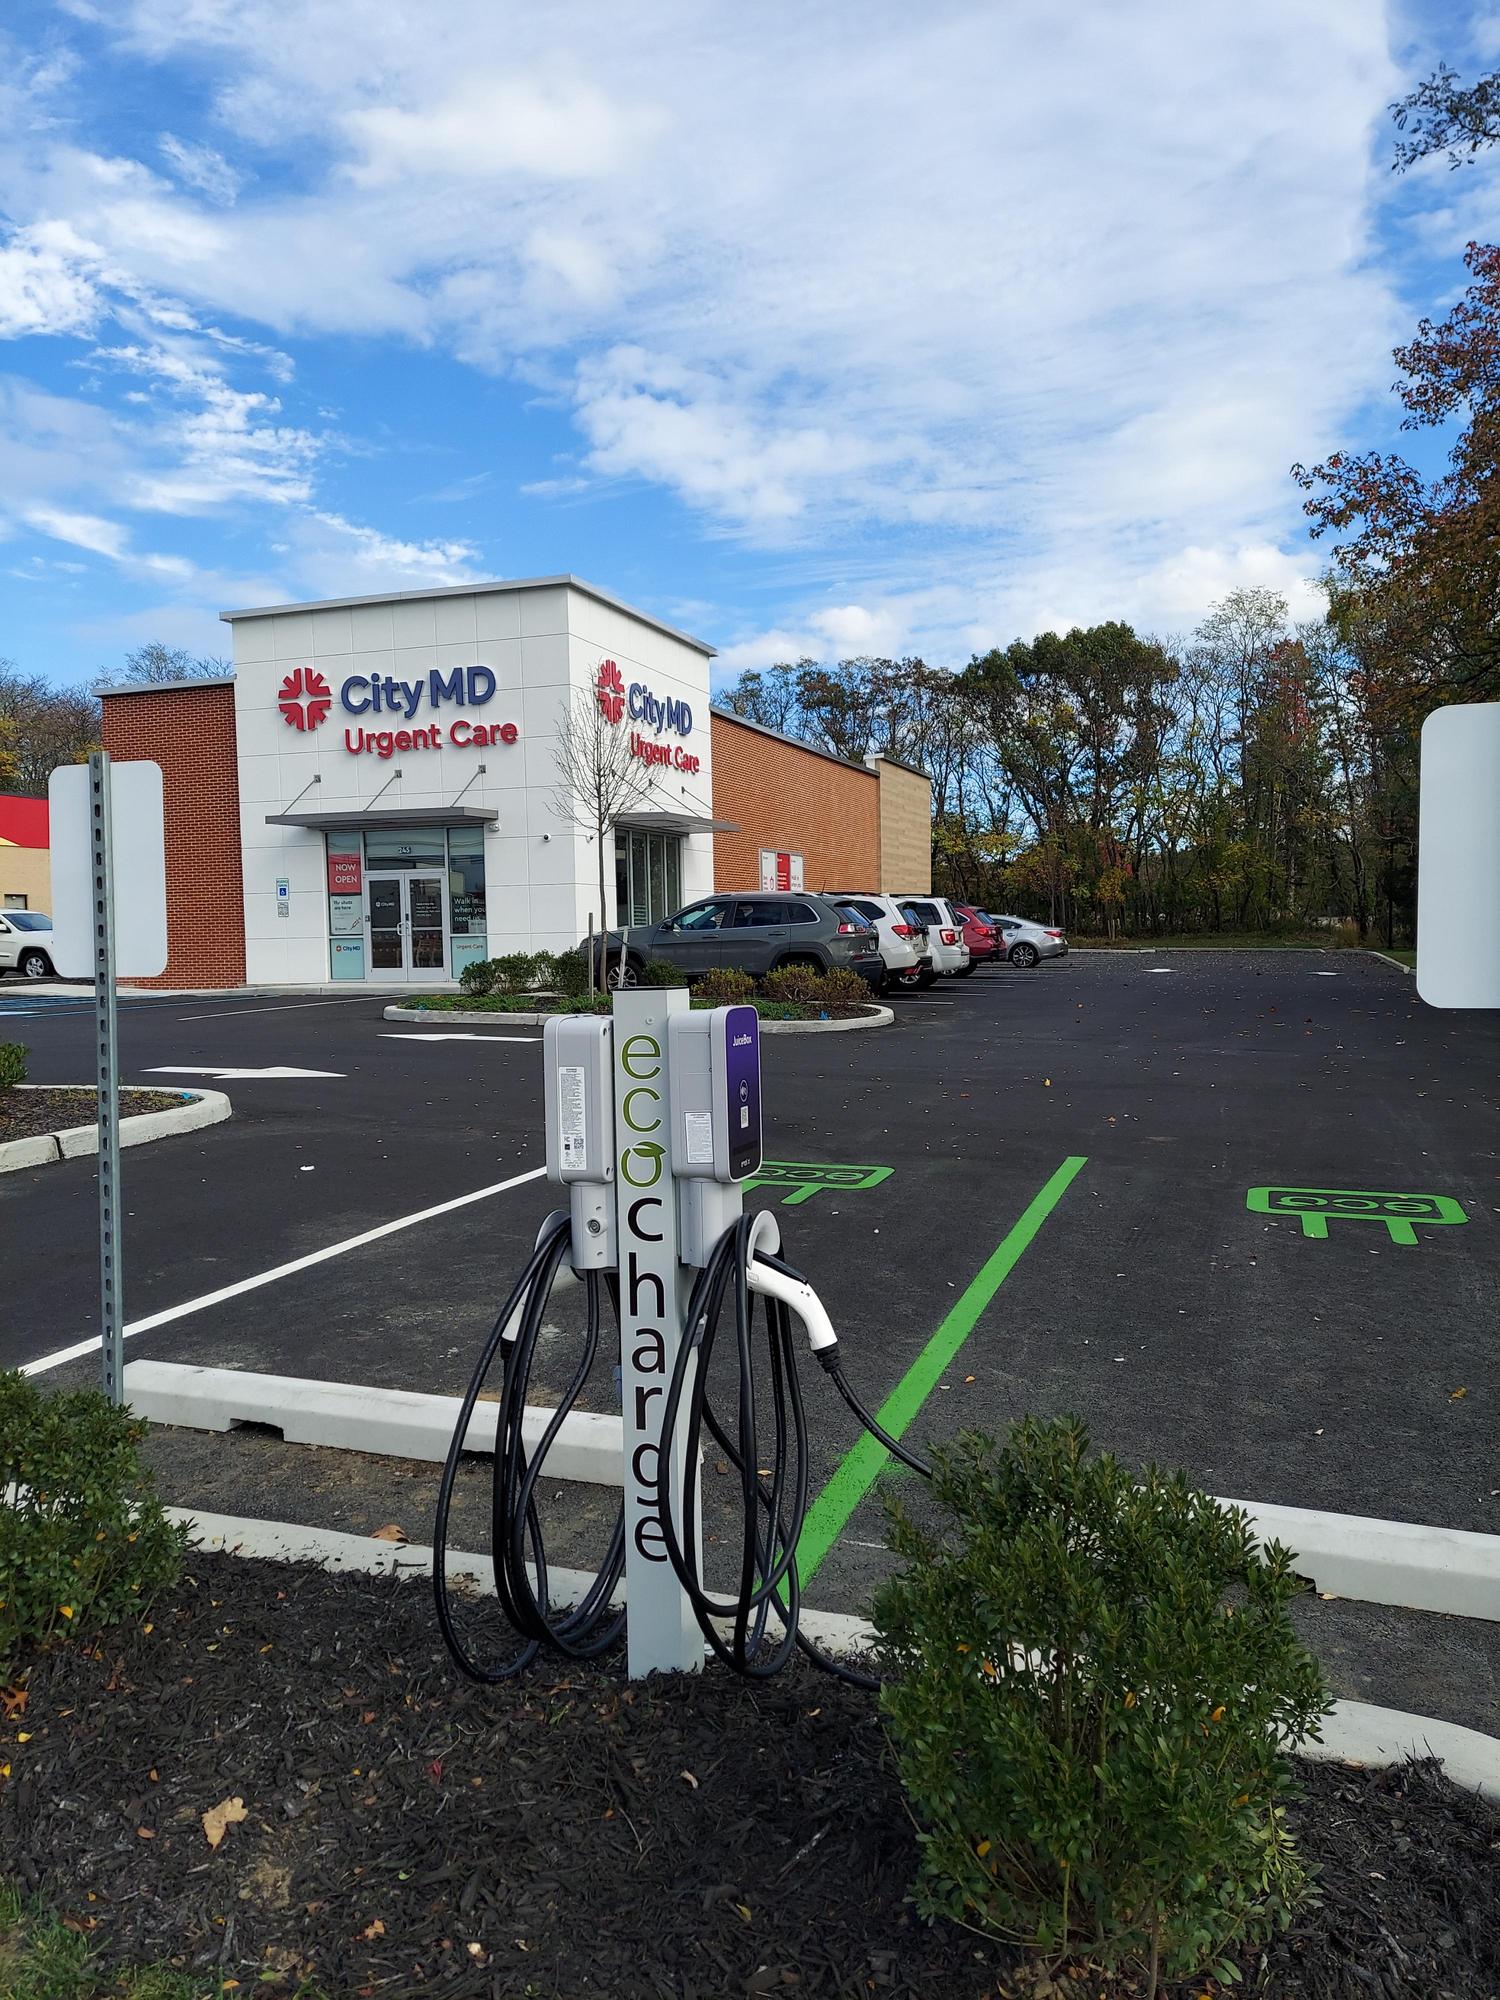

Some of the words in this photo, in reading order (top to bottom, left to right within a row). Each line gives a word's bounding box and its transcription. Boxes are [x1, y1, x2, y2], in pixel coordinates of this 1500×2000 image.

[340, 665, 497, 720] CityMD
[628, 682, 694, 736] CityMD
[344, 723, 443, 760] Urgent
[449, 719, 519, 749] Care
[629, 731, 673, 768] Urgent
[674, 745, 700, 774] Care
[335, 863, 357, 872] NOW
[335, 875, 358, 884] OPEN
[453, 896, 471, 905] Walk
[454, 905, 473, 913] when
[732, 1033, 753, 1047] JuiceBox
